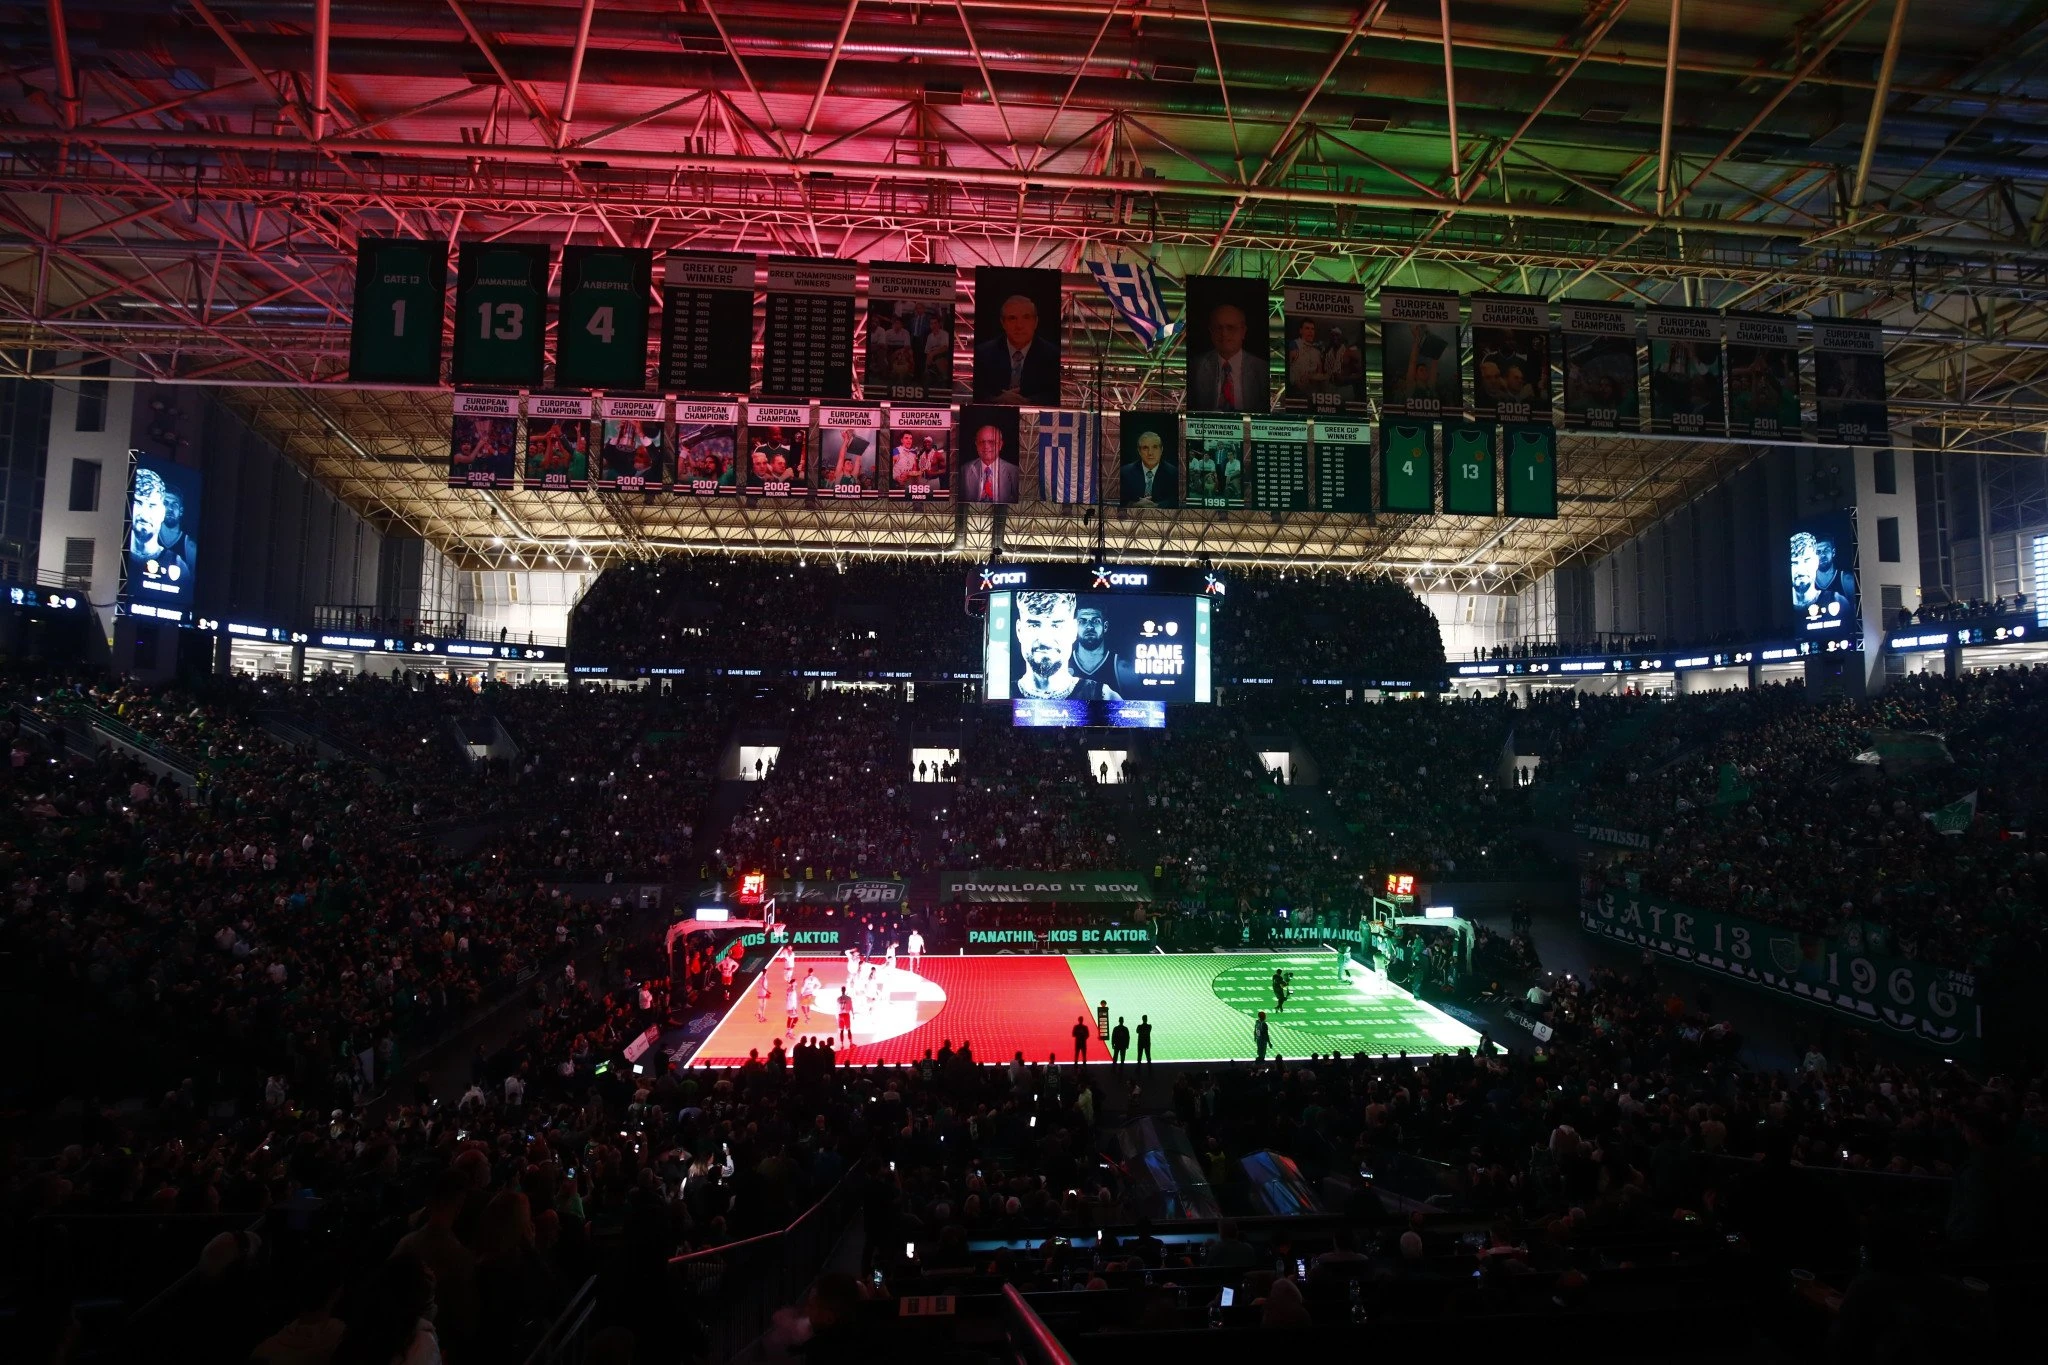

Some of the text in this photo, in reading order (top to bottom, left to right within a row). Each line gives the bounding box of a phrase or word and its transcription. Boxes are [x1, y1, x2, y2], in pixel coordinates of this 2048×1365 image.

[682, 263, 738, 274] GREEK CUP
[384, 274, 407, 284] GATE
[686, 273, 733, 284] WINNERS
[770, 270, 856, 281] GREEK CHAMPIONSHIP
[794, 279, 830, 288] WINNERS
[872, 276, 951, 288] INTERCONTINENTAL
[882, 285, 941, 296] CUP WINNERS
[1299, 293, 1350, 304] EUROPEAN
[1296, 302, 1354, 314] CHAMPIONS
[1395, 300, 1445, 310] EUROPEAN
[1486, 304, 1535, 316] EUROPEAN
[392, 300, 406, 336] 1
[1392, 308, 1448, 320] CHAMPIONS
[1482, 313, 1538, 326] CHAMPIONS
[1574, 311, 1622, 322] EUROPEAN
[478, 302, 524, 340] 13
[586, 306, 615, 344] 4
[1572, 320, 1626, 332] CHAMPIONS
[1660, 317, 1708, 328] EUROPEAN
[1658, 326, 1711, 338] CHAMPIONS
[1738, 322, 1784, 334] EUROPEAN
[1736, 332, 1788, 344] CHAMPIONS
[1825, 329, 1871, 340] EUROPEAN
[1823, 337, 1874, 349] CHAMPIONS
[892, 386, 924, 398] 1996
[466, 398, 507, 406] EUROPEAN
[540, 400, 580, 408] EUROPEAN
[1312, 393, 1342, 405] 1996
[1406, 398, 1440, 410] 2000
[462, 404, 509, 413] CHAMPIONS
[536, 406, 582, 415] CHAMPIONS
[614, 402, 654, 410] EUROPEAN
[688, 405, 727, 414] EUROPEAN
[1498, 403, 1530, 416] 2002
[610, 408, 656, 418] CHAMPIONS
[684, 412, 730, 421] CHAMPIONS
[759, 408, 799, 416] EUROPEAN
[830, 411, 870, 419] EUROPEAN
[1586, 408, 1618, 420] 2007
[756, 414, 800, 423] CHAMPIONS
[828, 418, 872, 426] CHAMPIONS
[1672, 414, 1704, 426] 2009
[1754, 418, 1778, 430] 2011
[1838, 423, 1868, 436] 2024
[1402, 460, 1414, 476] 4
[1462, 464, 1479, 480] 13
[1528, 466, 1534, 480] 1
[468, 472, 496, 482] 2024
[546, 474, 567, 484] 2011
[616, 476, 644, 486] 2009
[692, 480, 719, 490] 2007
[764, 482, 790, 492] 2002
[834, 484, 861, 494] 2000
[908, 484, 930, 494] 1996
[1204, 498, 1226, 507] 1996
[1136, 644, 1182, 660] GAME
[1134, 658, 1184, 674] NIGHT
[1588, 826, 1650, 850] PATISSIA
[742, 883, 758, 894] 24
[952, 883, 1062, 892] DOWNLOAD
[1396, 883, 1412, 894] 24
[844, 888, 896, 901] 1908
[770, 931, 839, 944] BC AKTOR
[1082, 930, 1100, 942] BC
[1104, 930, 1149, 942] AKTOR
[1598, 892, 1958, 1018] GATE 13 1966
[1948, 970, 1976, 986] FREE
[1520, 1016, 1535, 1031] Uber
